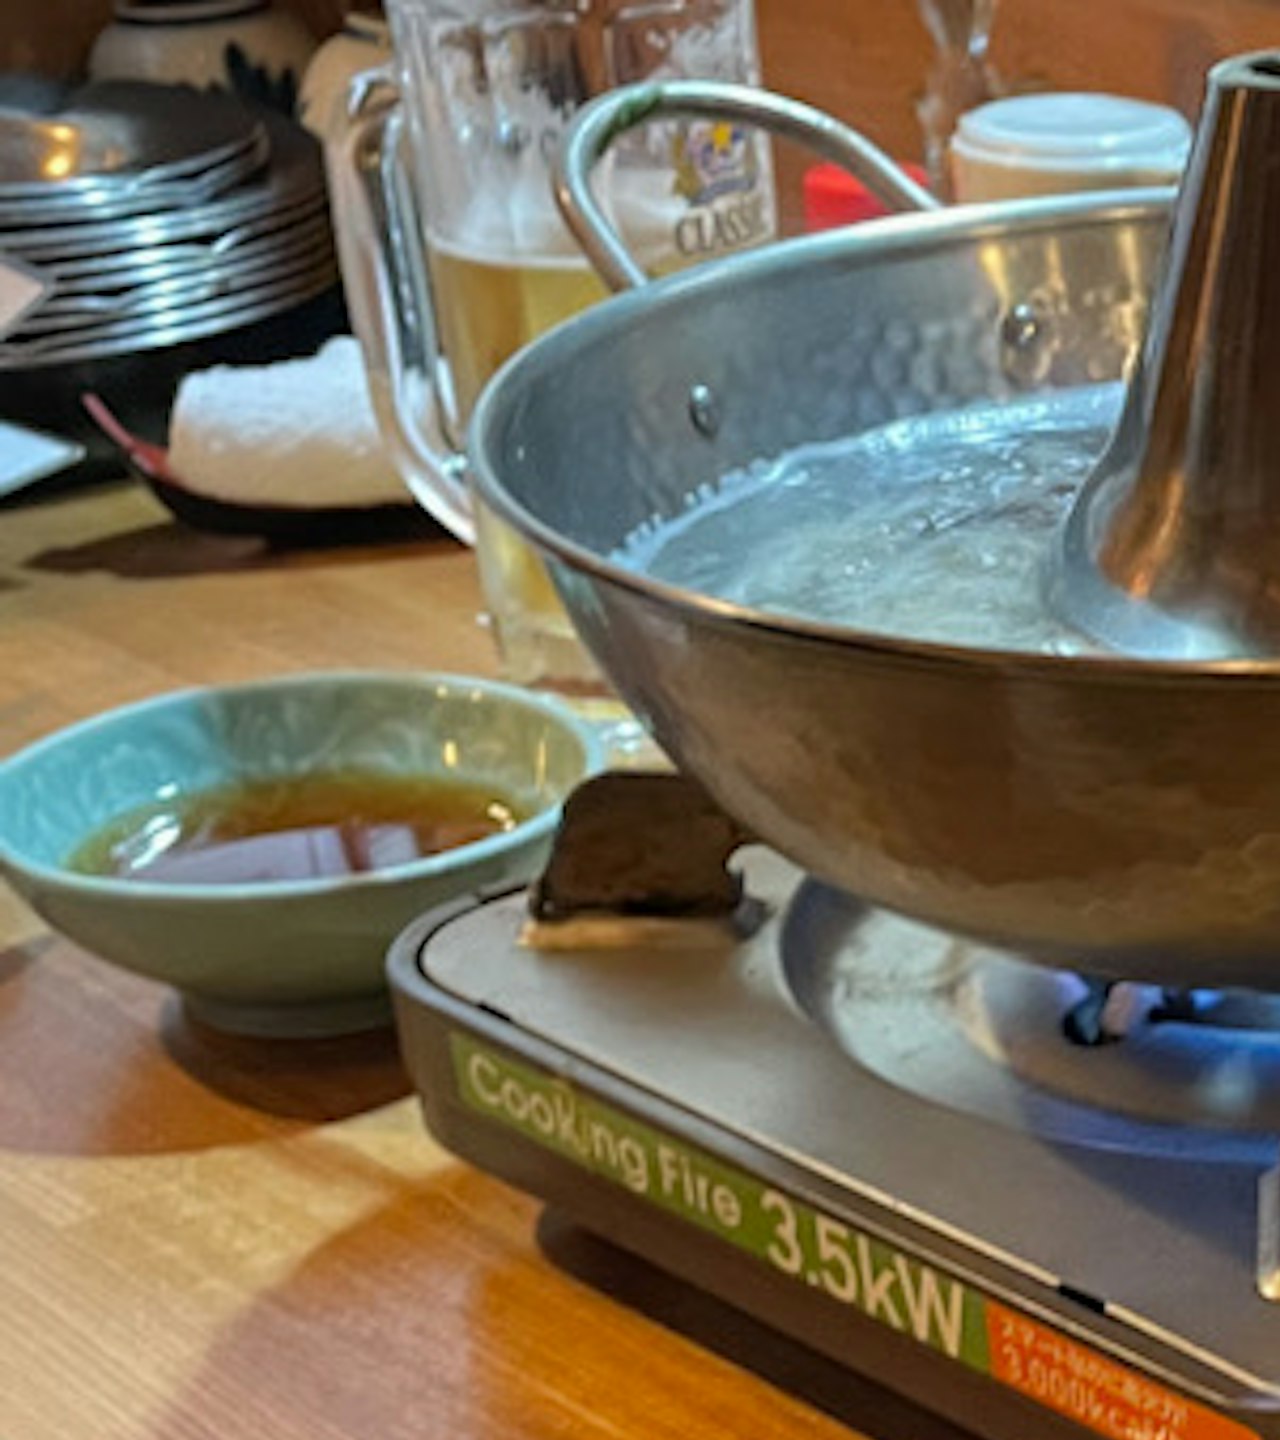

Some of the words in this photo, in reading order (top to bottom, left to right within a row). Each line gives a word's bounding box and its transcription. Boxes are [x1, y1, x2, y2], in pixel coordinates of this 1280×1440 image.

[469, 1052, 648, 1194] Cooking
[658, 1143, 742, 1228] Fire
[760, 1189, 964, 1361] 3.5kW
